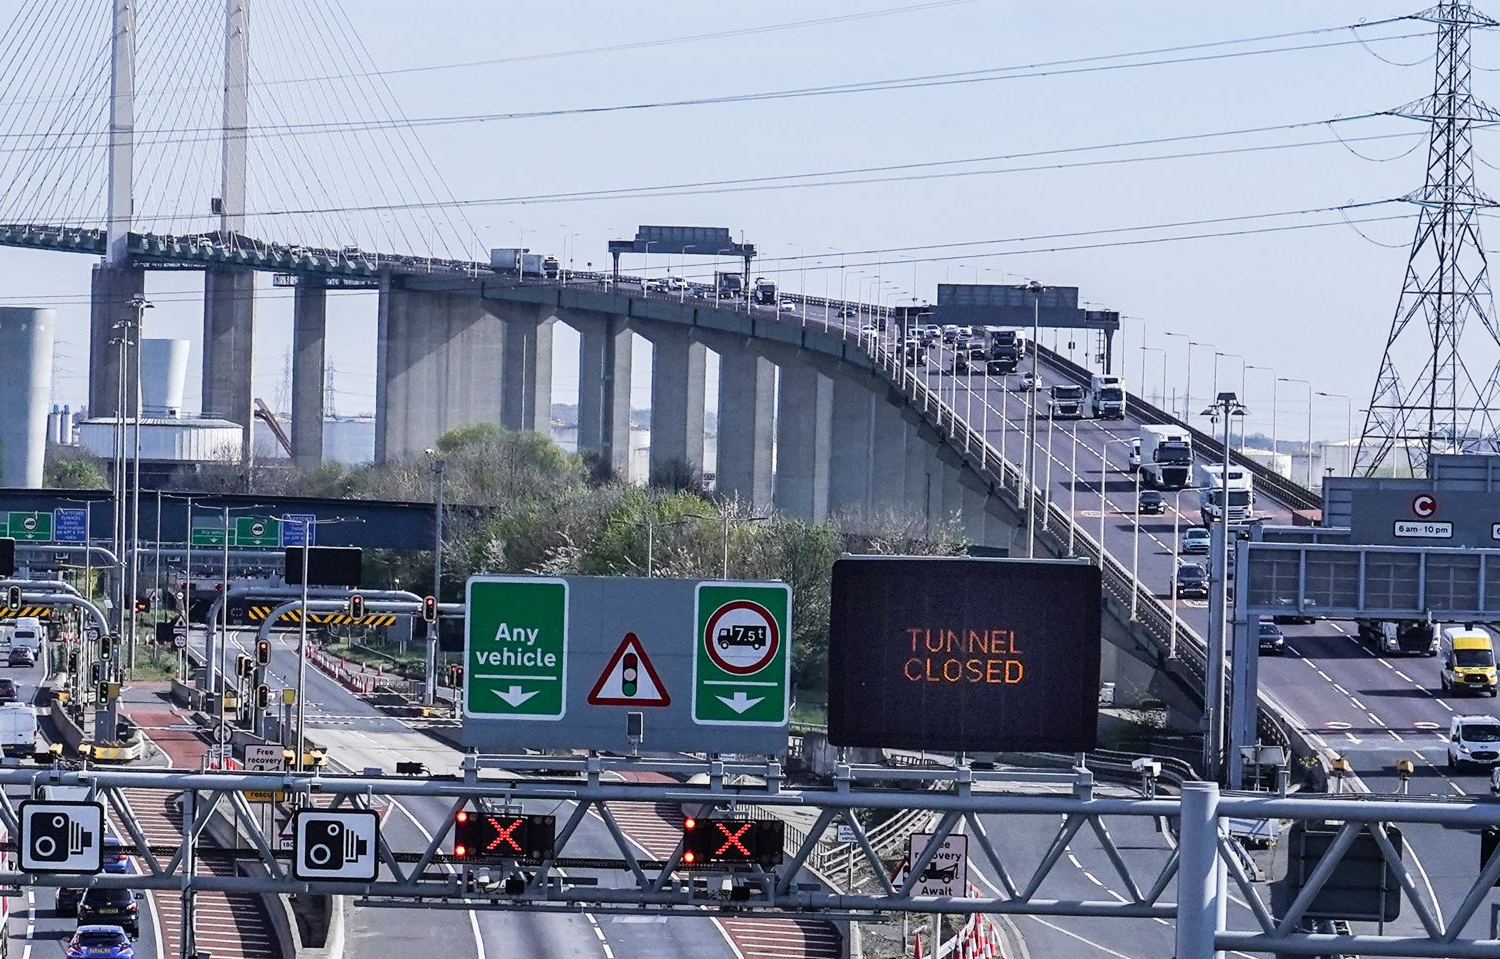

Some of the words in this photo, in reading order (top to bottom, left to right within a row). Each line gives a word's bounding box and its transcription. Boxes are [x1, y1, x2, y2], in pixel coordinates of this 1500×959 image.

[1436, 527, 1448, 536] pm
[495, 623, 539, 645] Any
[907, 628, 1023, 654] TUNNEL
[475, 648, 557, 667] vehicle
[904, 658, 1024, 684] CLOSED
[256, 748, 274, 756] Free
[914, 852, 962, 862] rovery
[921, 886, 953, 896] Await
